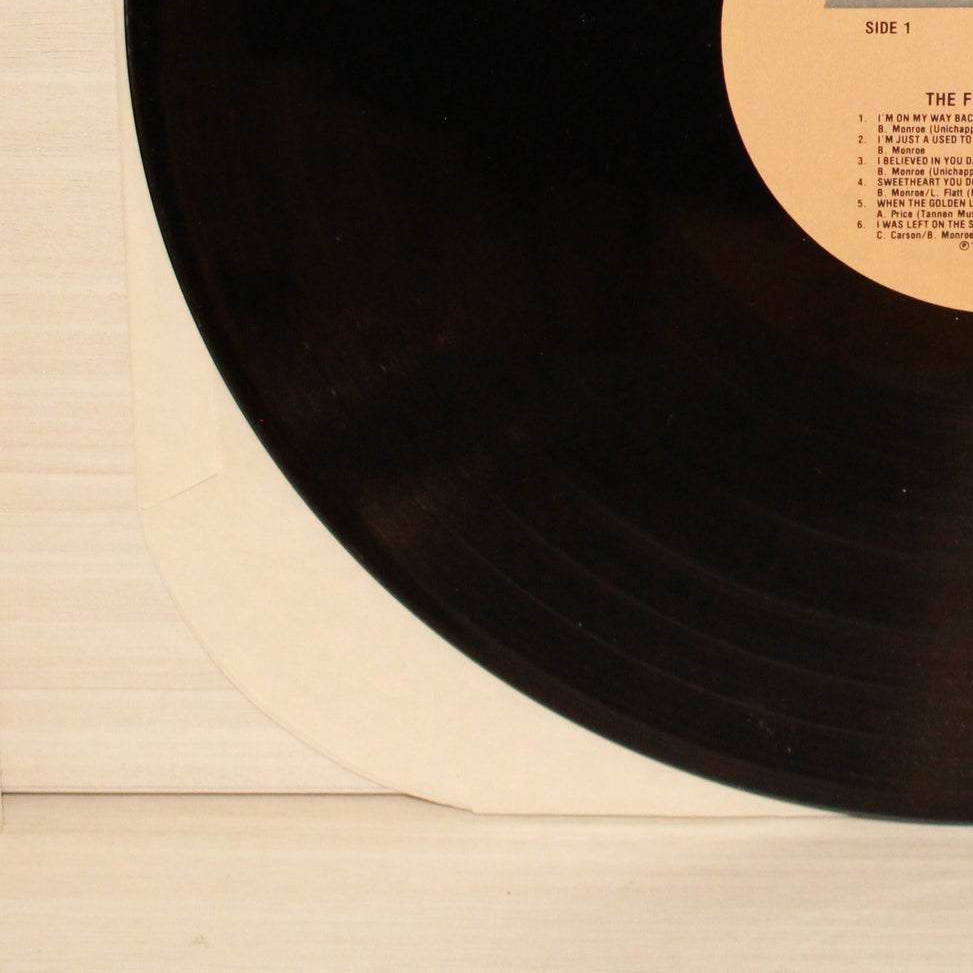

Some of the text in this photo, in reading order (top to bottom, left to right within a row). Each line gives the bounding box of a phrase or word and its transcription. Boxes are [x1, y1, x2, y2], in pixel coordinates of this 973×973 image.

[866, 21, 910, 34] SIDE 1
[926, 92, 956, 106] THE
[859, 114, 866, 122] 1.
[897, 114, 909, 122] ON
[913, 114, 927, 122] MY
[930, 114, 951, 122] WAY
[878, 124, 887, 133] B.
[893, 124, 925, 133] Monroe
[858, 135, 866, 144] 2.
[896, 135, 920, 144] JUST
[923, 135, 929, 143] A
[932, 135, 957, 144] USED
[960, 135, 972, 144] TO
[878, 146, 925, 154] B. Monroe
[858, 156, 866, 165] 3.
[877, 157, 881, 165] I
[883, 157, 928, 165] BELIEVED
[931, 157, 940, 165] IN
[944, 156, 962, 165] YOU
[878, 167, 886, 176] B.
[892, 167, 924, 175] Monroe
[858, 178, 865, 186] 4.
[878, 178, 940, 186] SWEETHEART
[944, 178, 962, 186] YOU
[877, 188, 886, 197] B.
[944, 188, 962, 197] Flatt
[858, 199, 865, 207] 5.
[877, 199, 905, 207] WHEN
[908, 199, 926, 207] THE
[929, 199, 965, 207] GOLDEN
[877, 210, 884, 218] A.
[891, 210, 912, 218] Price
[917, 210, 953, 219] (Tannen
[857, 220, 865, 229] 6.
[882, 220, 903, 229] WAS
[907, 220, 928, 229] LEFT
[932, 220, 944, 229] ON
[948, 220, 965, 228] THE
[877, 231, 885, 239] C.
[941, 231, 973, 240] Monroe
